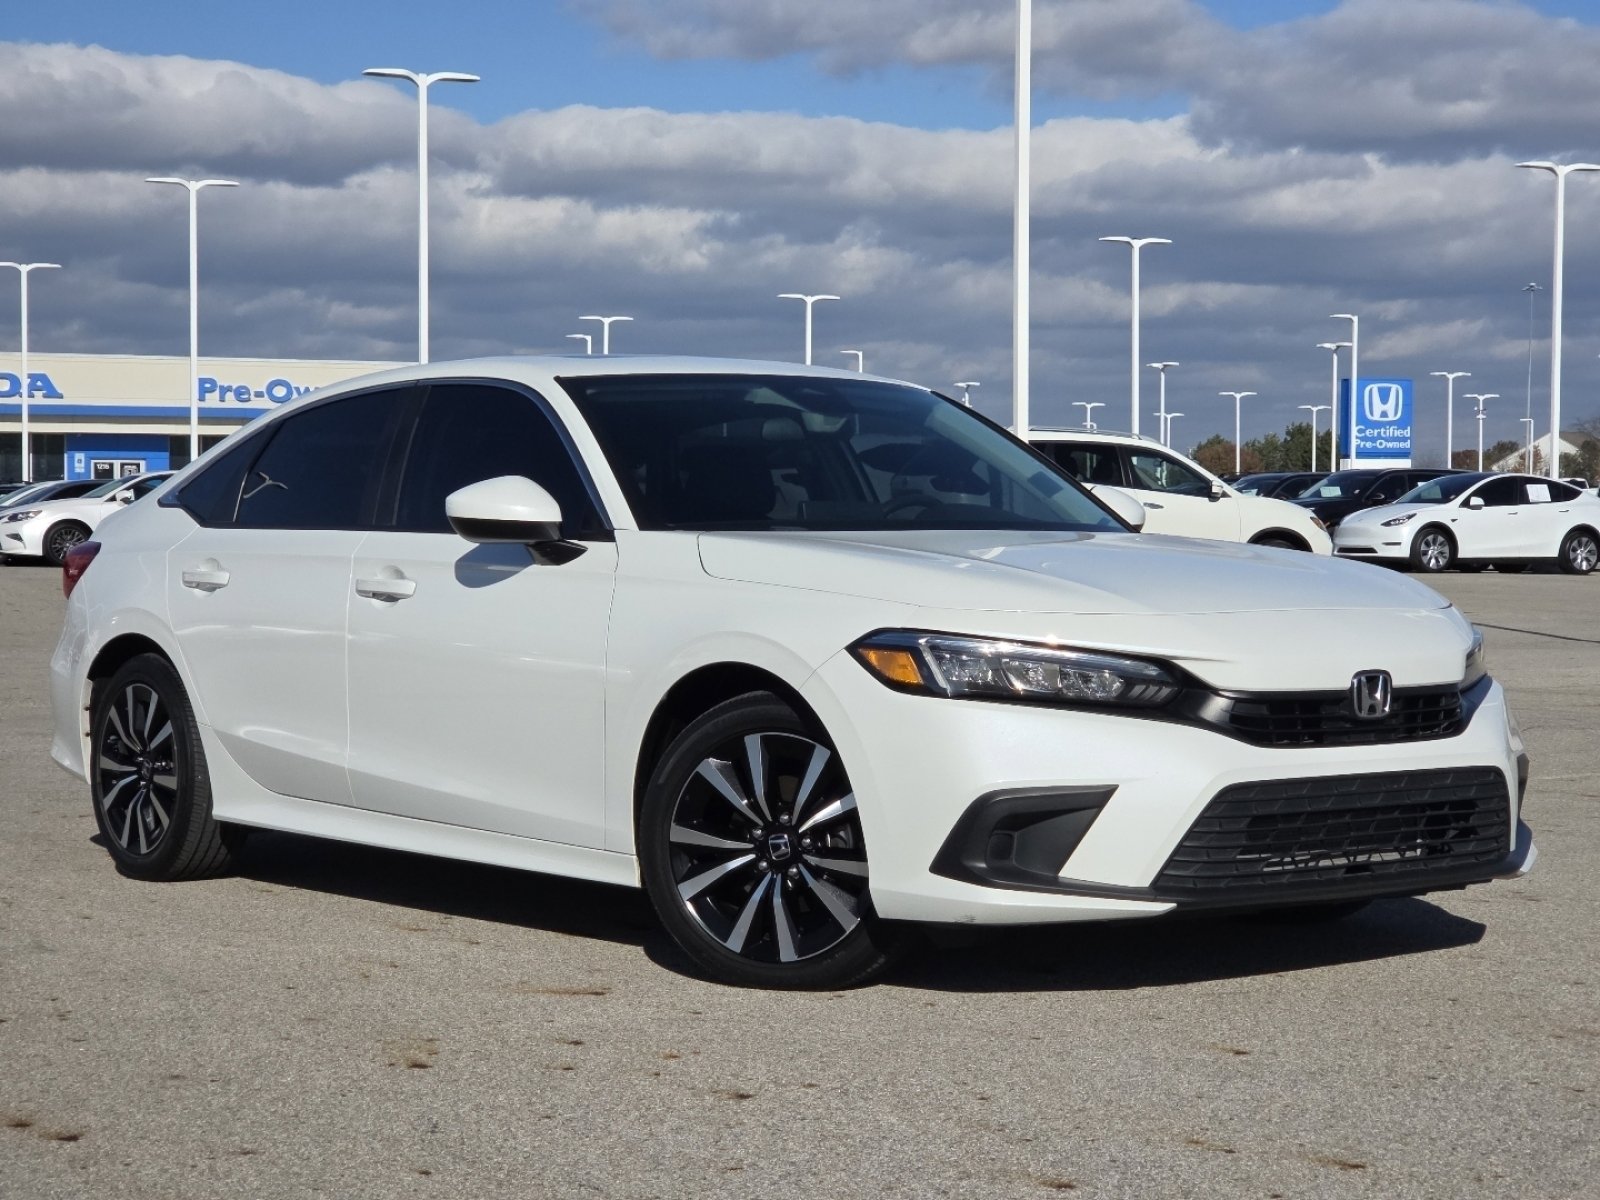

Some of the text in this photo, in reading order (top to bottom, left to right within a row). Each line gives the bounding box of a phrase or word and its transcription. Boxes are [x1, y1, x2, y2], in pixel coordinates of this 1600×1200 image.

[198, 377, 321, 403] Pre-Ow
[1355, 425, 1411, 437] Certified
[1355, 439, 1411, 449] Pre-Owned
